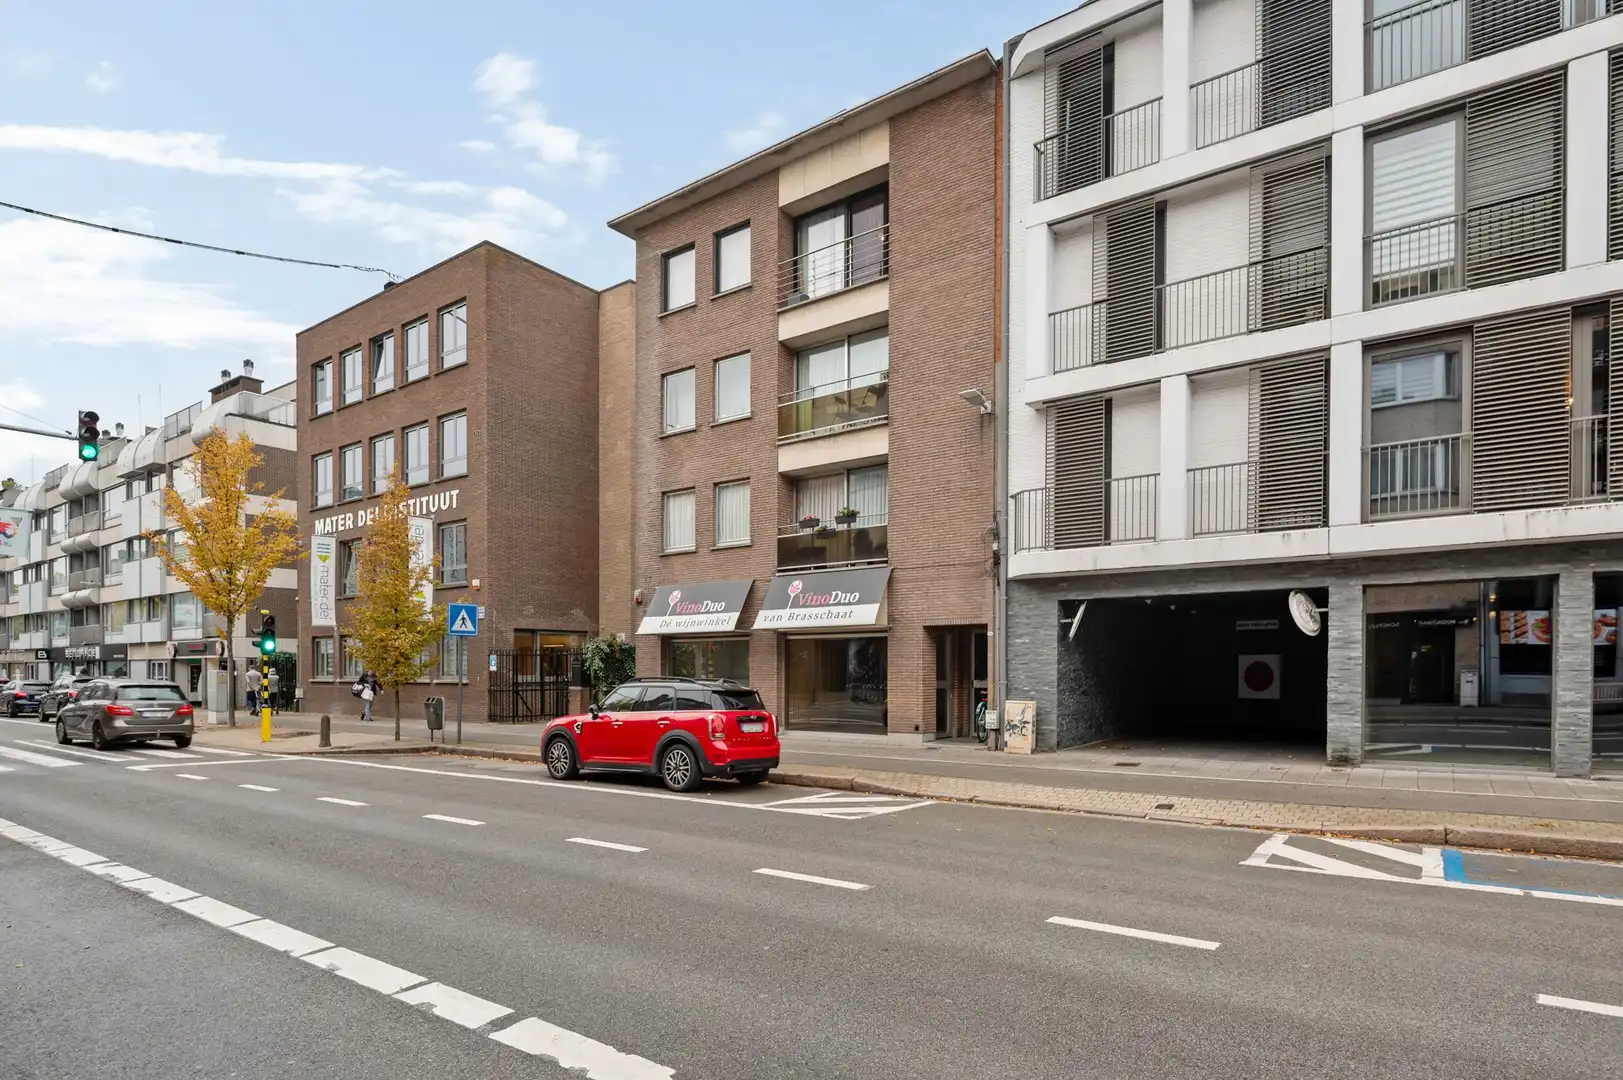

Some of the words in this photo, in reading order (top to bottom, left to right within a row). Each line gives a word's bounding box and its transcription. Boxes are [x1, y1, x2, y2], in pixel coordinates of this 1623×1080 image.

[315, 513, 354, 535] MATER
[358, 506, 379, 527] DEI
[383, 489, 460, 520] ISTITUUT
[320, 565, 333, 599] mater
[799, 590, 860, 606] VinoDuo
[320, 602, 333, 620] dei
[675, 600, 726, 614] VinoDuo
[675, 616, 732, 628] wijnwinkel
[763, 614, 783, 622] van
[787, 609, 853, 621] Brasschaat
